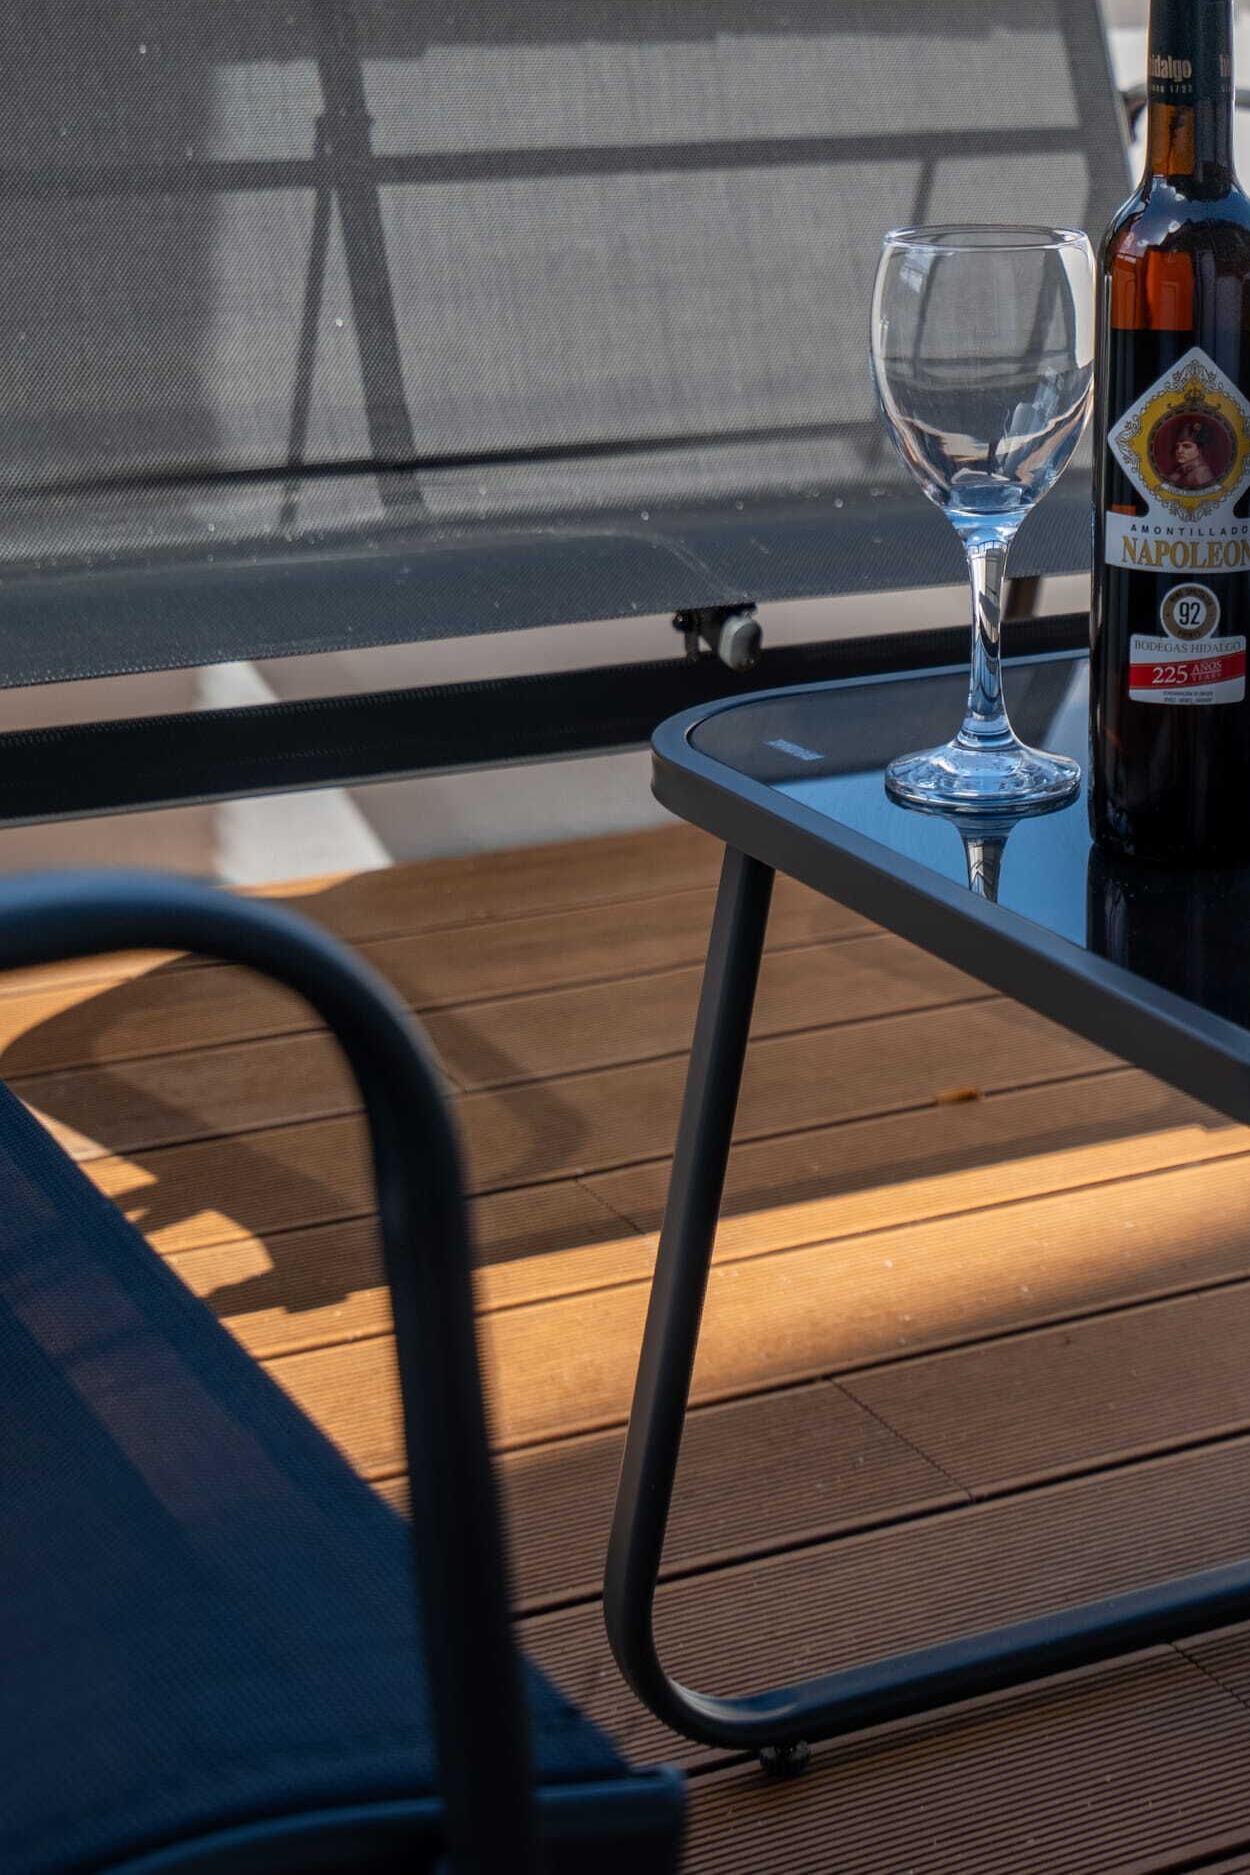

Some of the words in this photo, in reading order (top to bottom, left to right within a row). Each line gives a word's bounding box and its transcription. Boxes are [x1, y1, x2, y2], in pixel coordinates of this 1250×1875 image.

[1150, 54, 1193, 82] idalgo
[1130, 524, 1249, 537] AMONTILLADO
[1178, 601, 1201, 626] 92
[1134, 639, 1187, 654] BODEGAS
[1189, 640, 1242, 654] HIDALGO
[1151, 665, 1189, 684] 225
